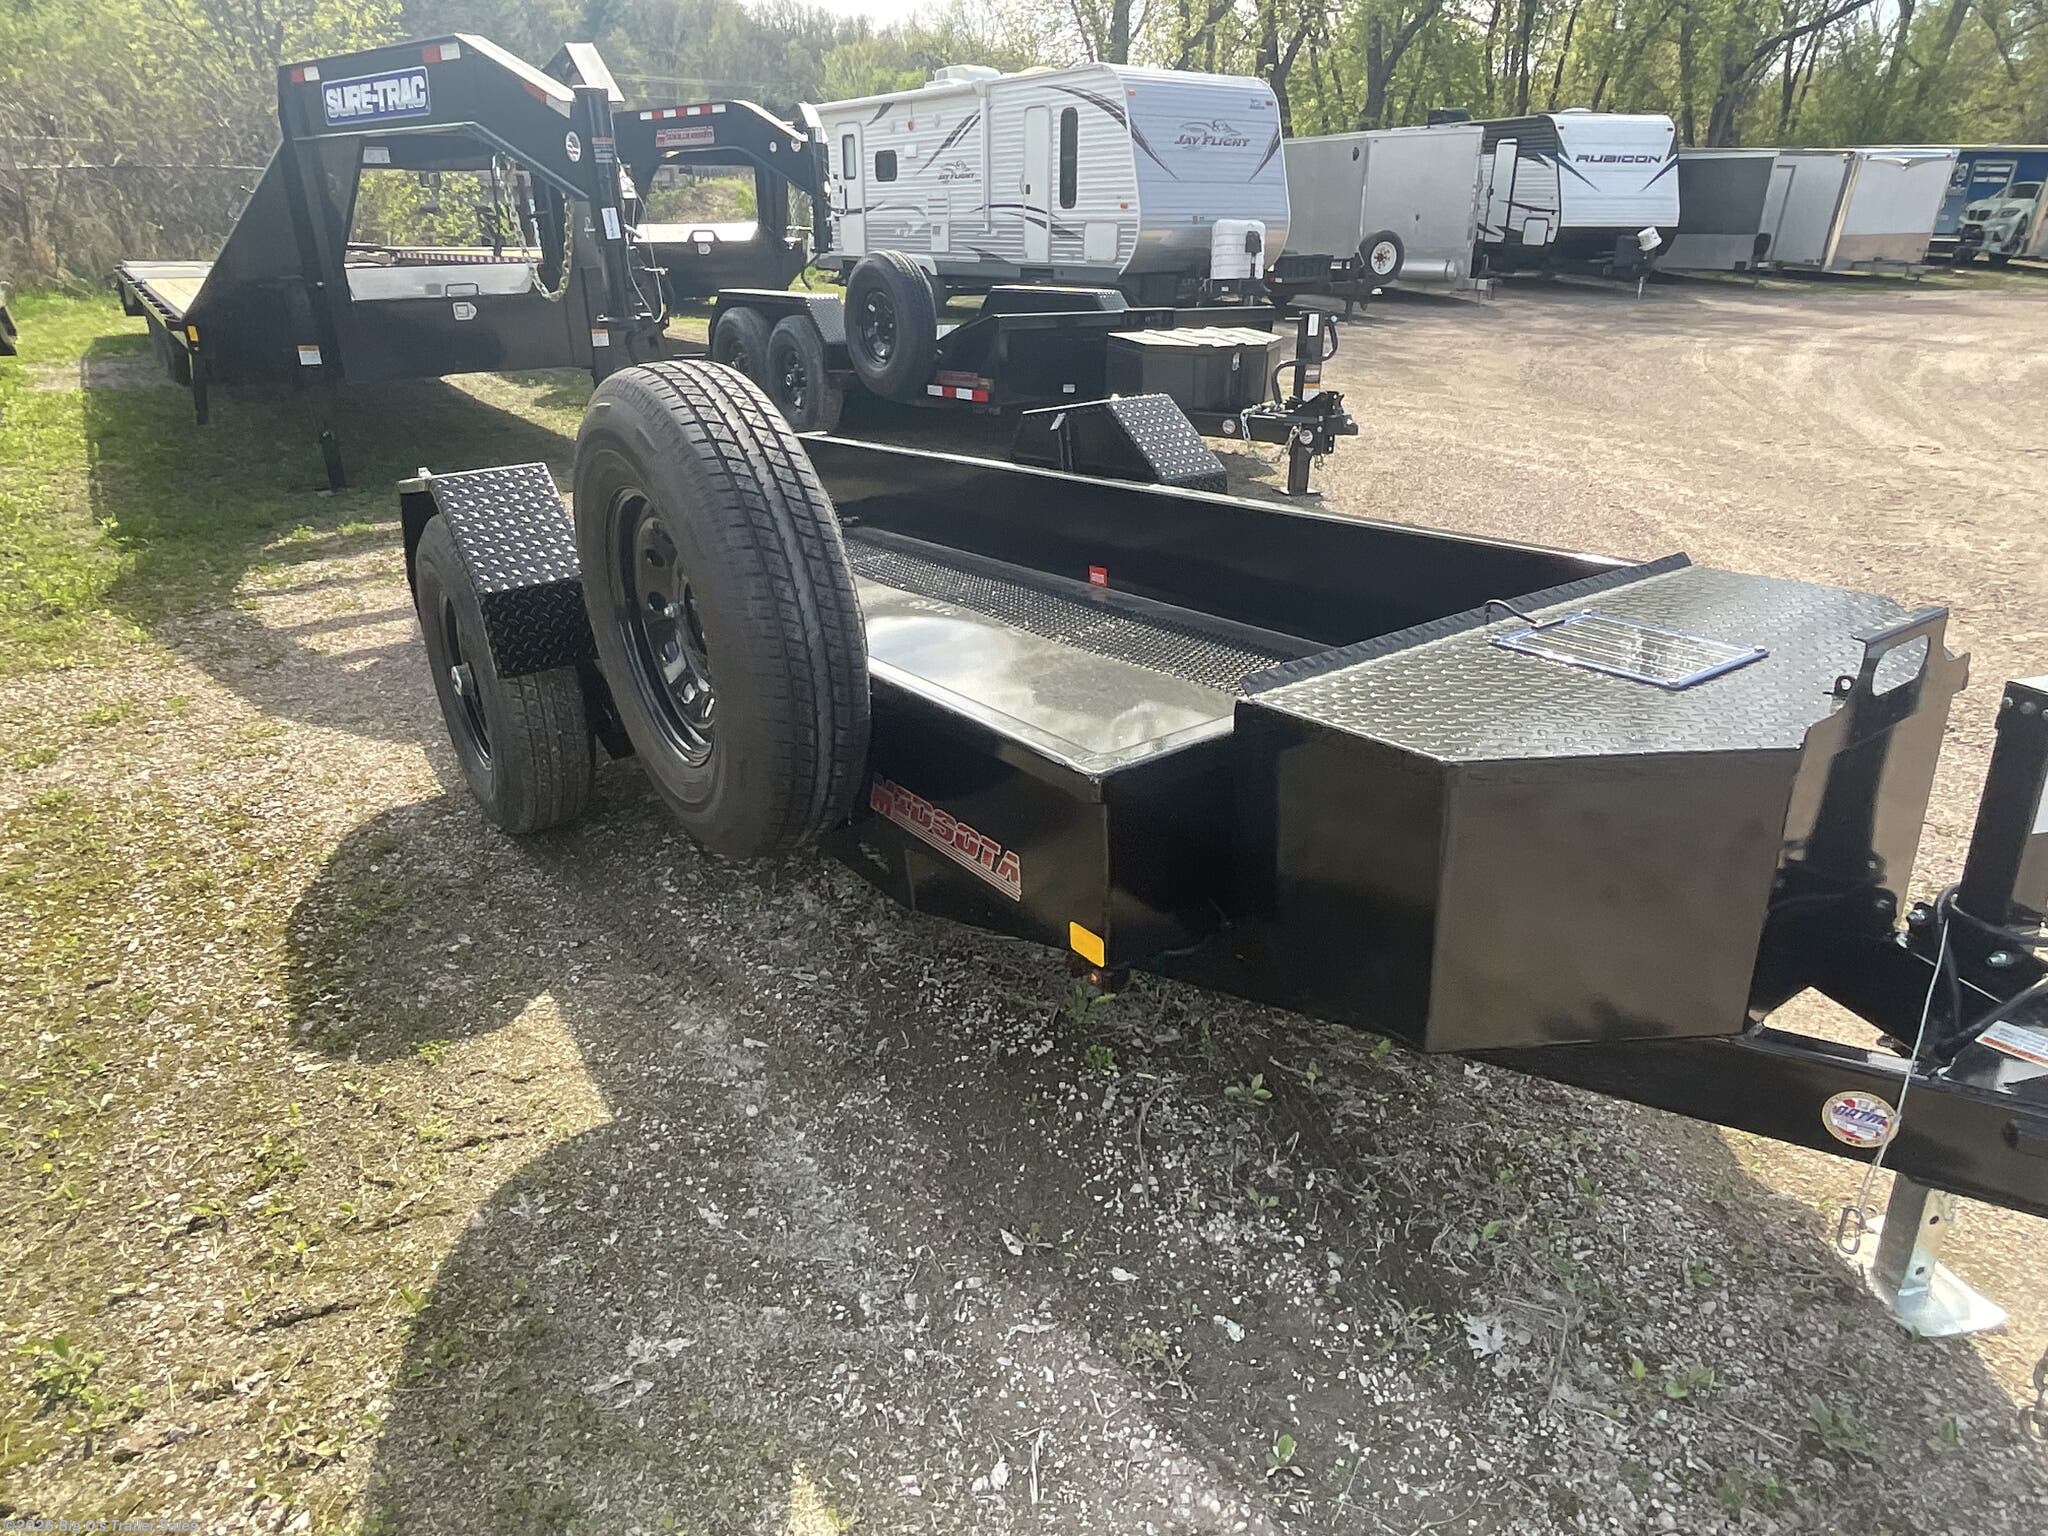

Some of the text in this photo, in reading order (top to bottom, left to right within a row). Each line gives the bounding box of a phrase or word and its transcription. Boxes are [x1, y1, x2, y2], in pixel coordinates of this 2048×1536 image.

[325, 75, 426, 118] SURE-TRAC
[1202, 132, 1250, 146] FLIGHT
[1575, 154, 1662, 163] RUBICON
